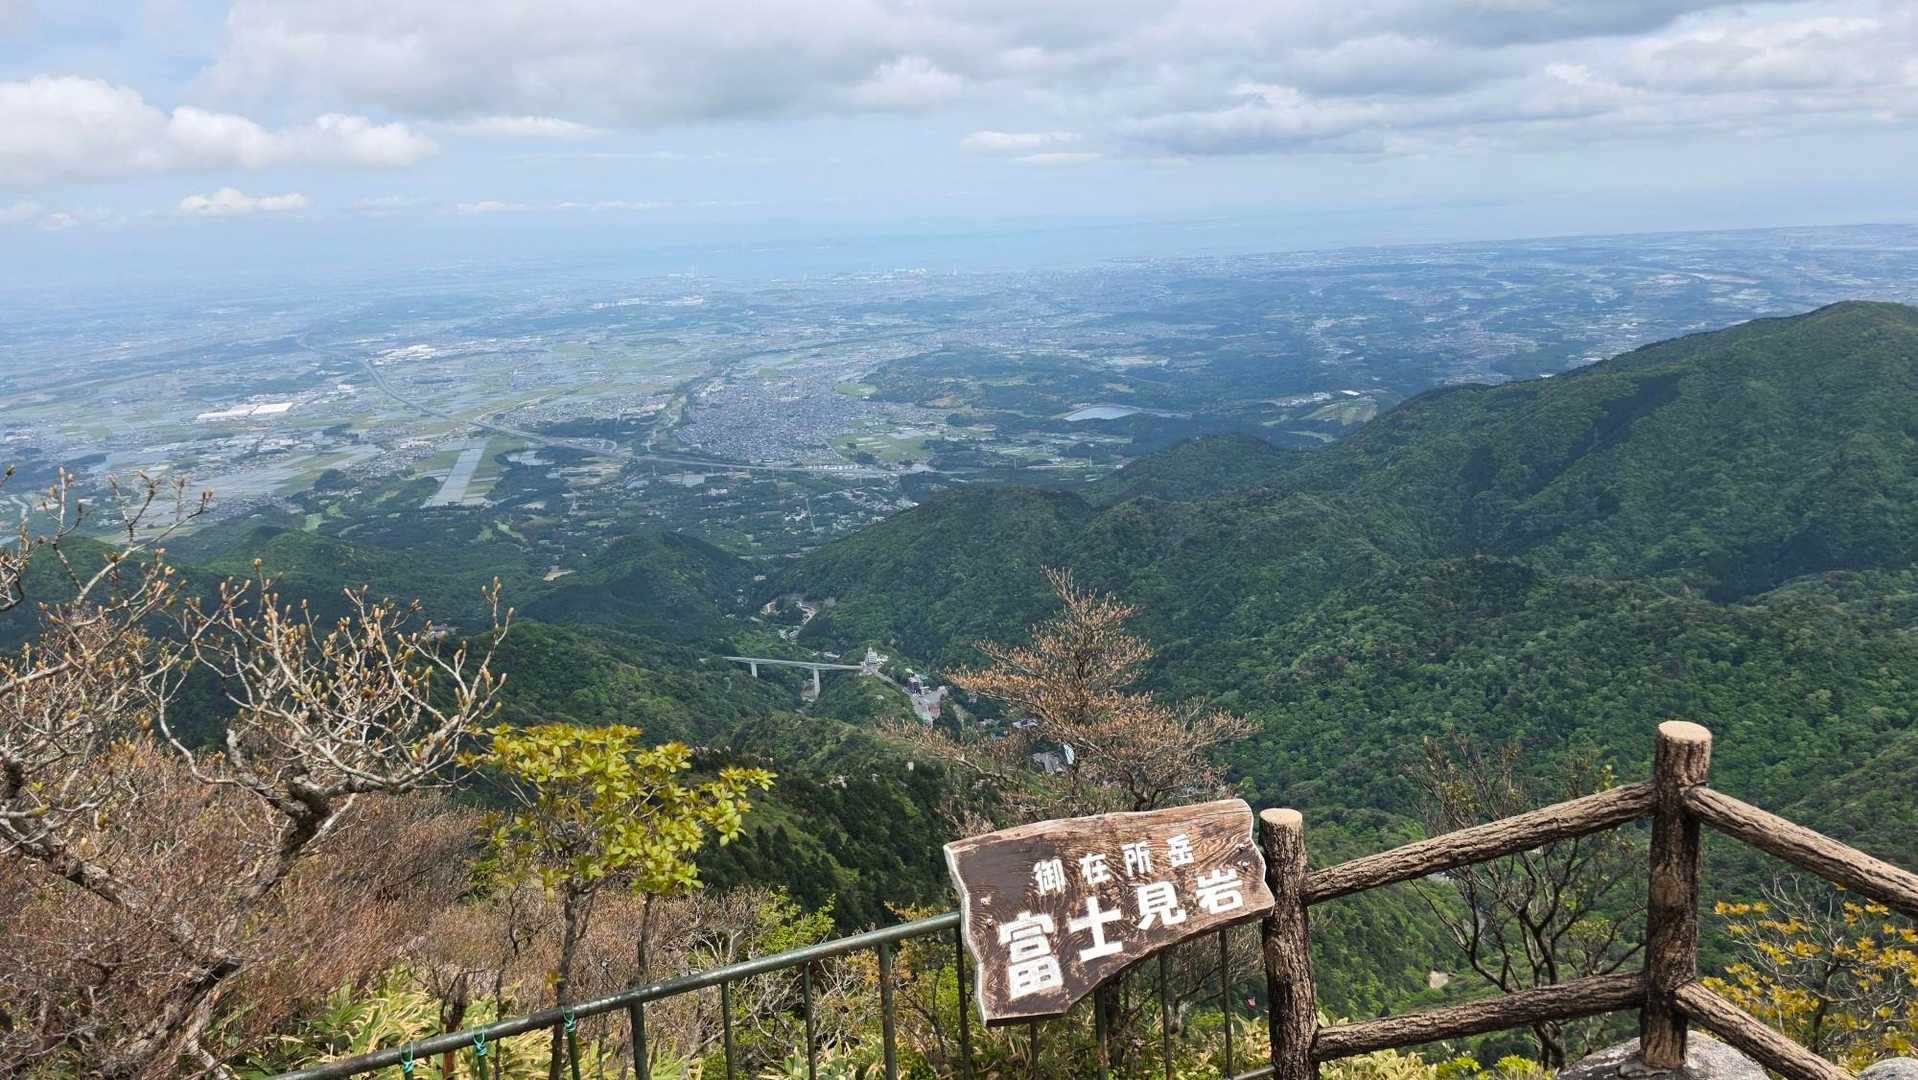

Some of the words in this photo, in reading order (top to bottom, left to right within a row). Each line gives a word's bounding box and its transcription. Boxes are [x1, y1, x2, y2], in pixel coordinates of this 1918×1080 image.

[1033, 833, 1195, 896] 御在所岳
[998, 868, 1244, 1000] 富士見岩
